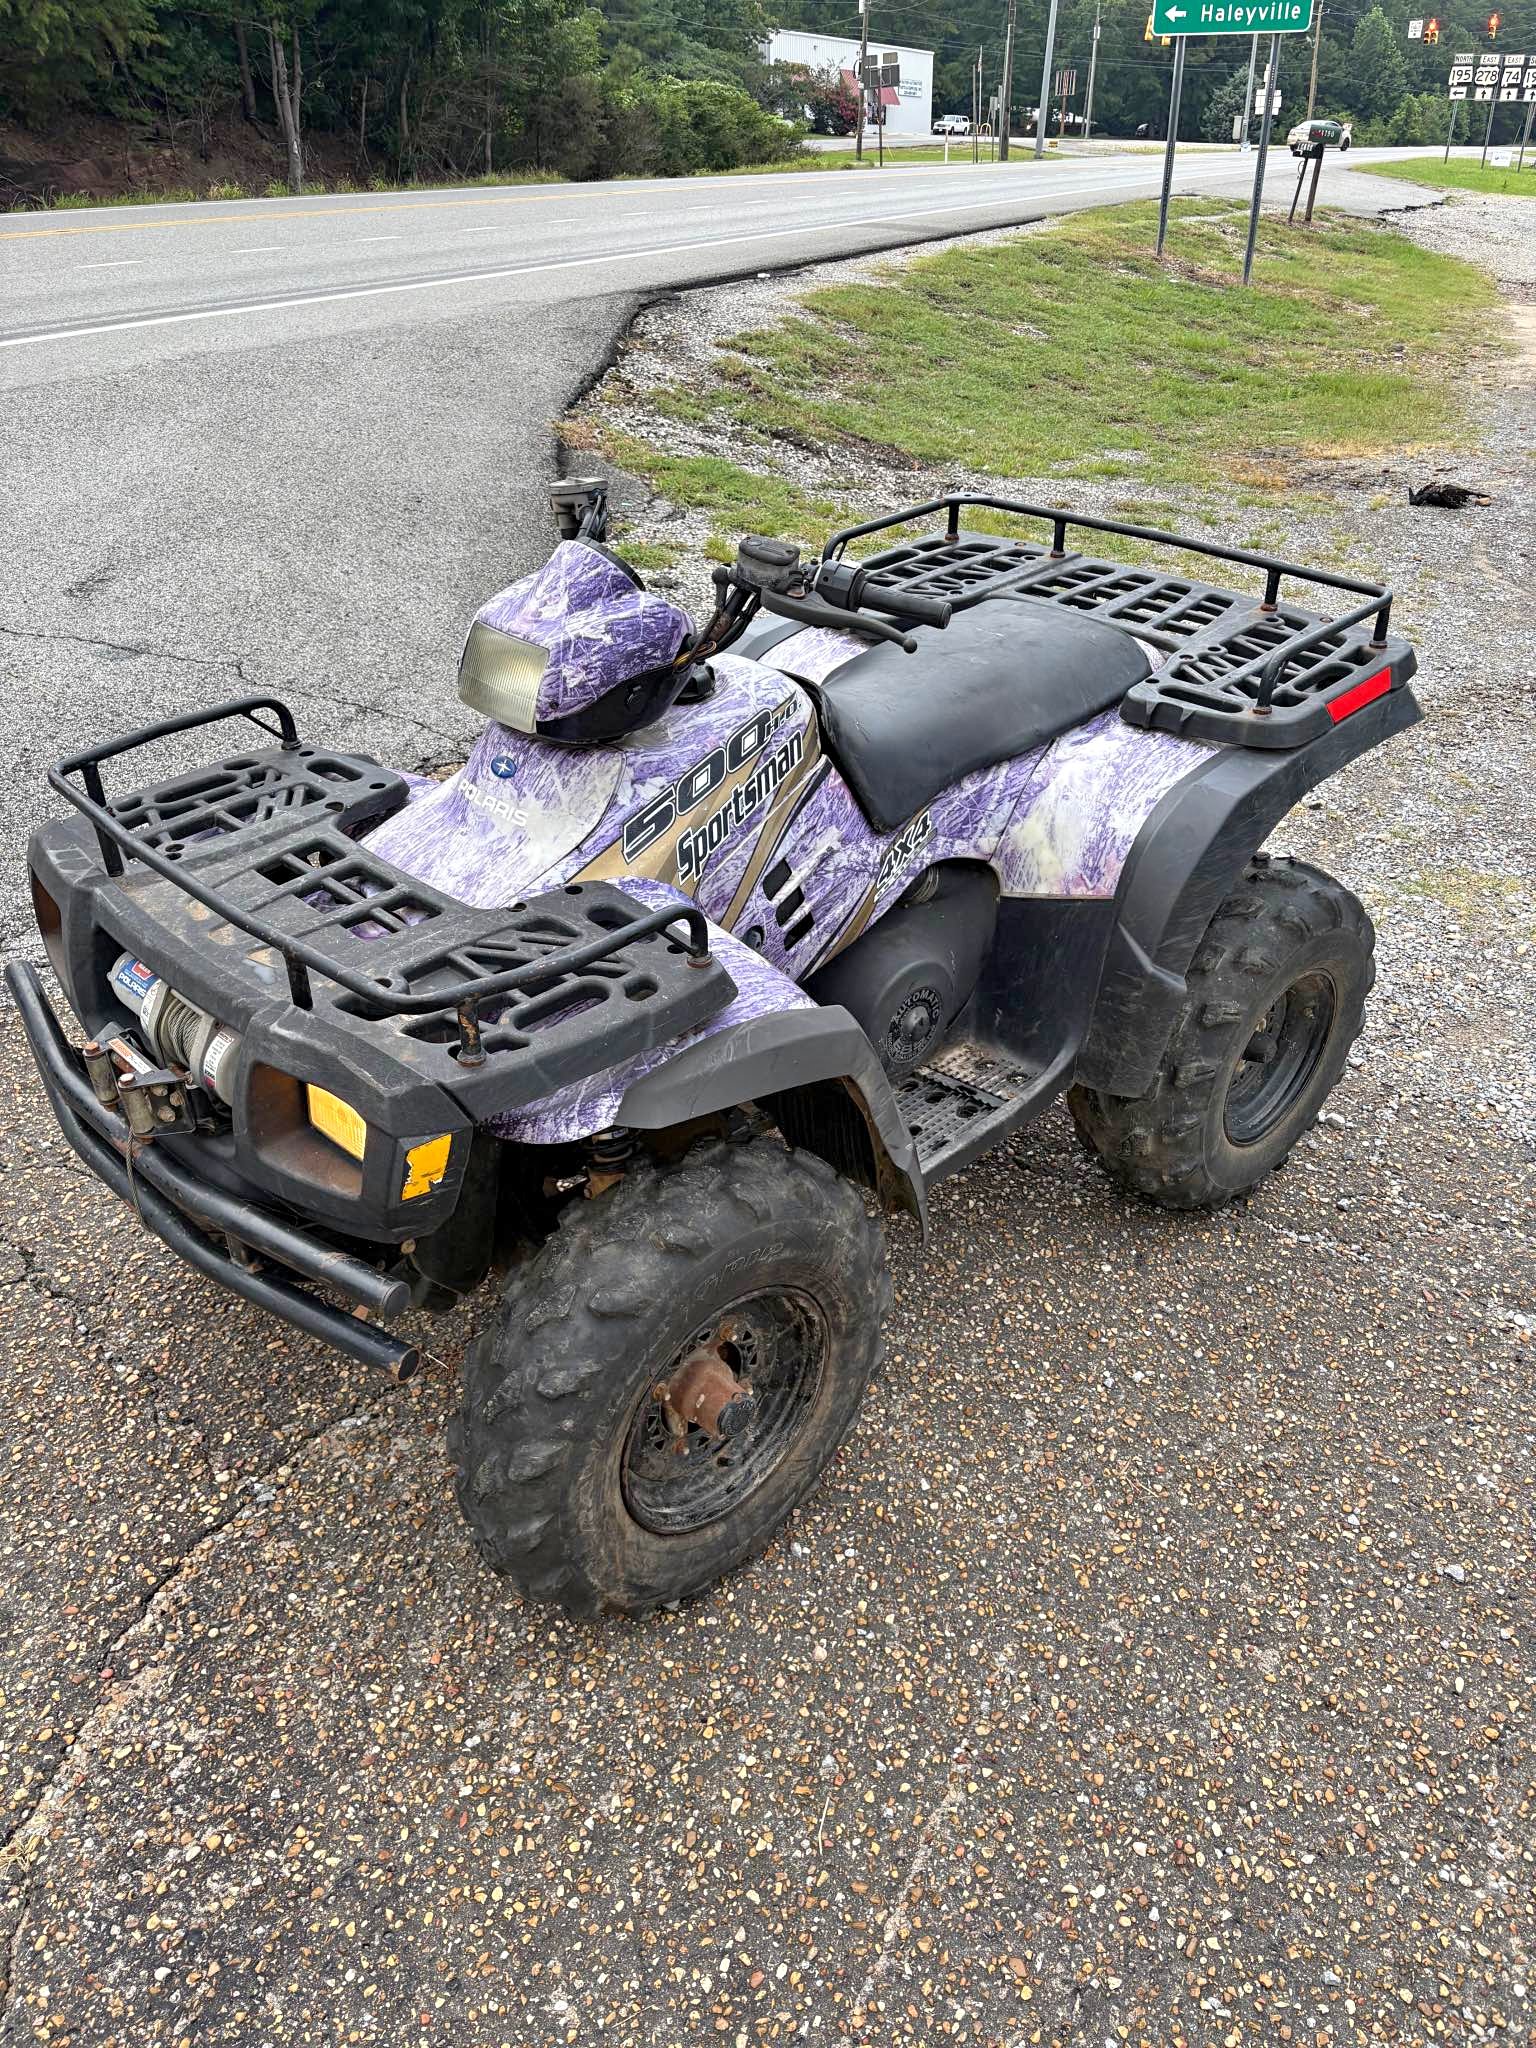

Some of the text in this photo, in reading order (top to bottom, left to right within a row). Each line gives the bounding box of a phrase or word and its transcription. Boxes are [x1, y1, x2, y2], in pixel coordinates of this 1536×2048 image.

[1200, 2, 1301, 26] Haleyville
[1455, 55, 1473, 63] NORTH
[1482, 55, 1497, 63] EAST
[1507, 56, 1522, 64] EAST
[1451, 69, 1471, 81] 195
[1475, 70, 1498, 82] 278
[1505, 71, 1520, 82] 74
[623, 708, 773, 865] 500
[458, 778, 529, 827] POLARIS
[676, 729, 804, 886] Sportsman
[118, 971, 147, 998] POLARIS
[890, 988, 940, 1025] AUTOMATIC
